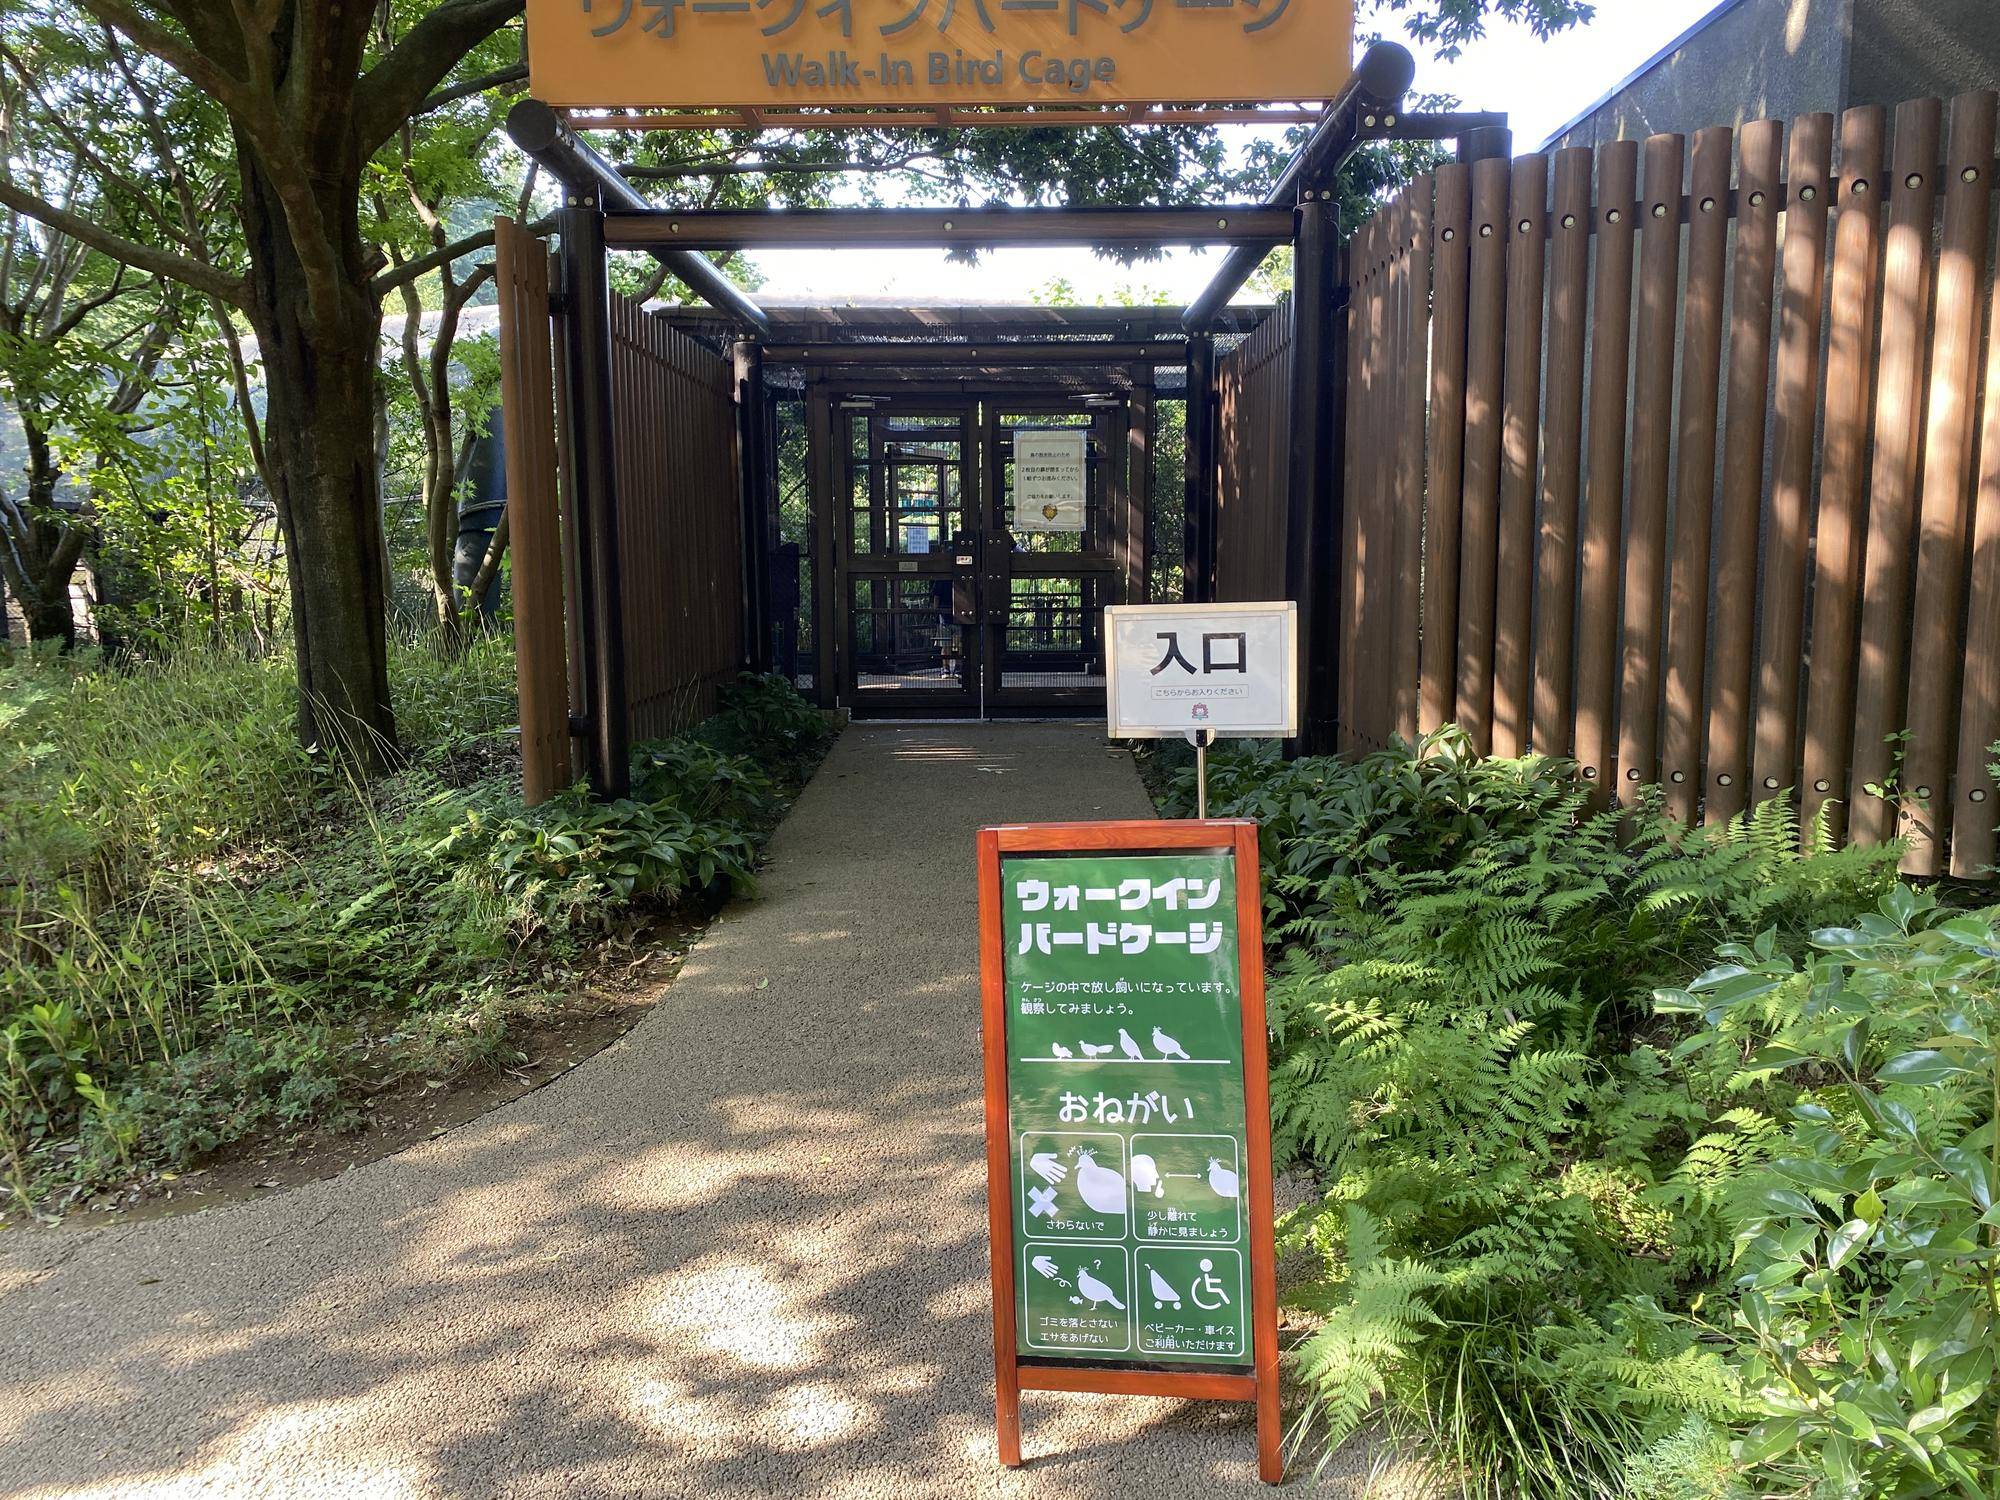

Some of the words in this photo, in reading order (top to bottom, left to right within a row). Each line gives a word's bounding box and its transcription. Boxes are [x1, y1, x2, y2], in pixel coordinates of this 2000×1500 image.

[763, 51, 914, 88] Walk-In
[927, 49, 1004, 86] Bird
[1019, 50, 1116, 94] Cage
[1150, 632, 1247, 676] 入口
[1155, 687, 1243, 697] こちらからお入りください
[1016, 877, 1221, 911] ウォークイン
[1018, 921, 1223, 955] バードケージ
[1020, 981, 1231, 995] ケージの中で放し飼いになっています。
[1020, 1002, 1134, 1015] 観察してみましょう。
[1058, 1090, 1195, 1125] おねがい
[1147, 1210, 1197, 1222] 少し離れて
[1046, 1219, 1105, 1231] さわらないで
[1147, 1226, 1228, 1238] 静かに見ましょう
[1039, 1316, 1118, 1329] ゴミを落とさない
[1040, 1332, 1109, 1344] エサをあげない
[1145, 1338, 1236, 1351] ご利用いただけます
